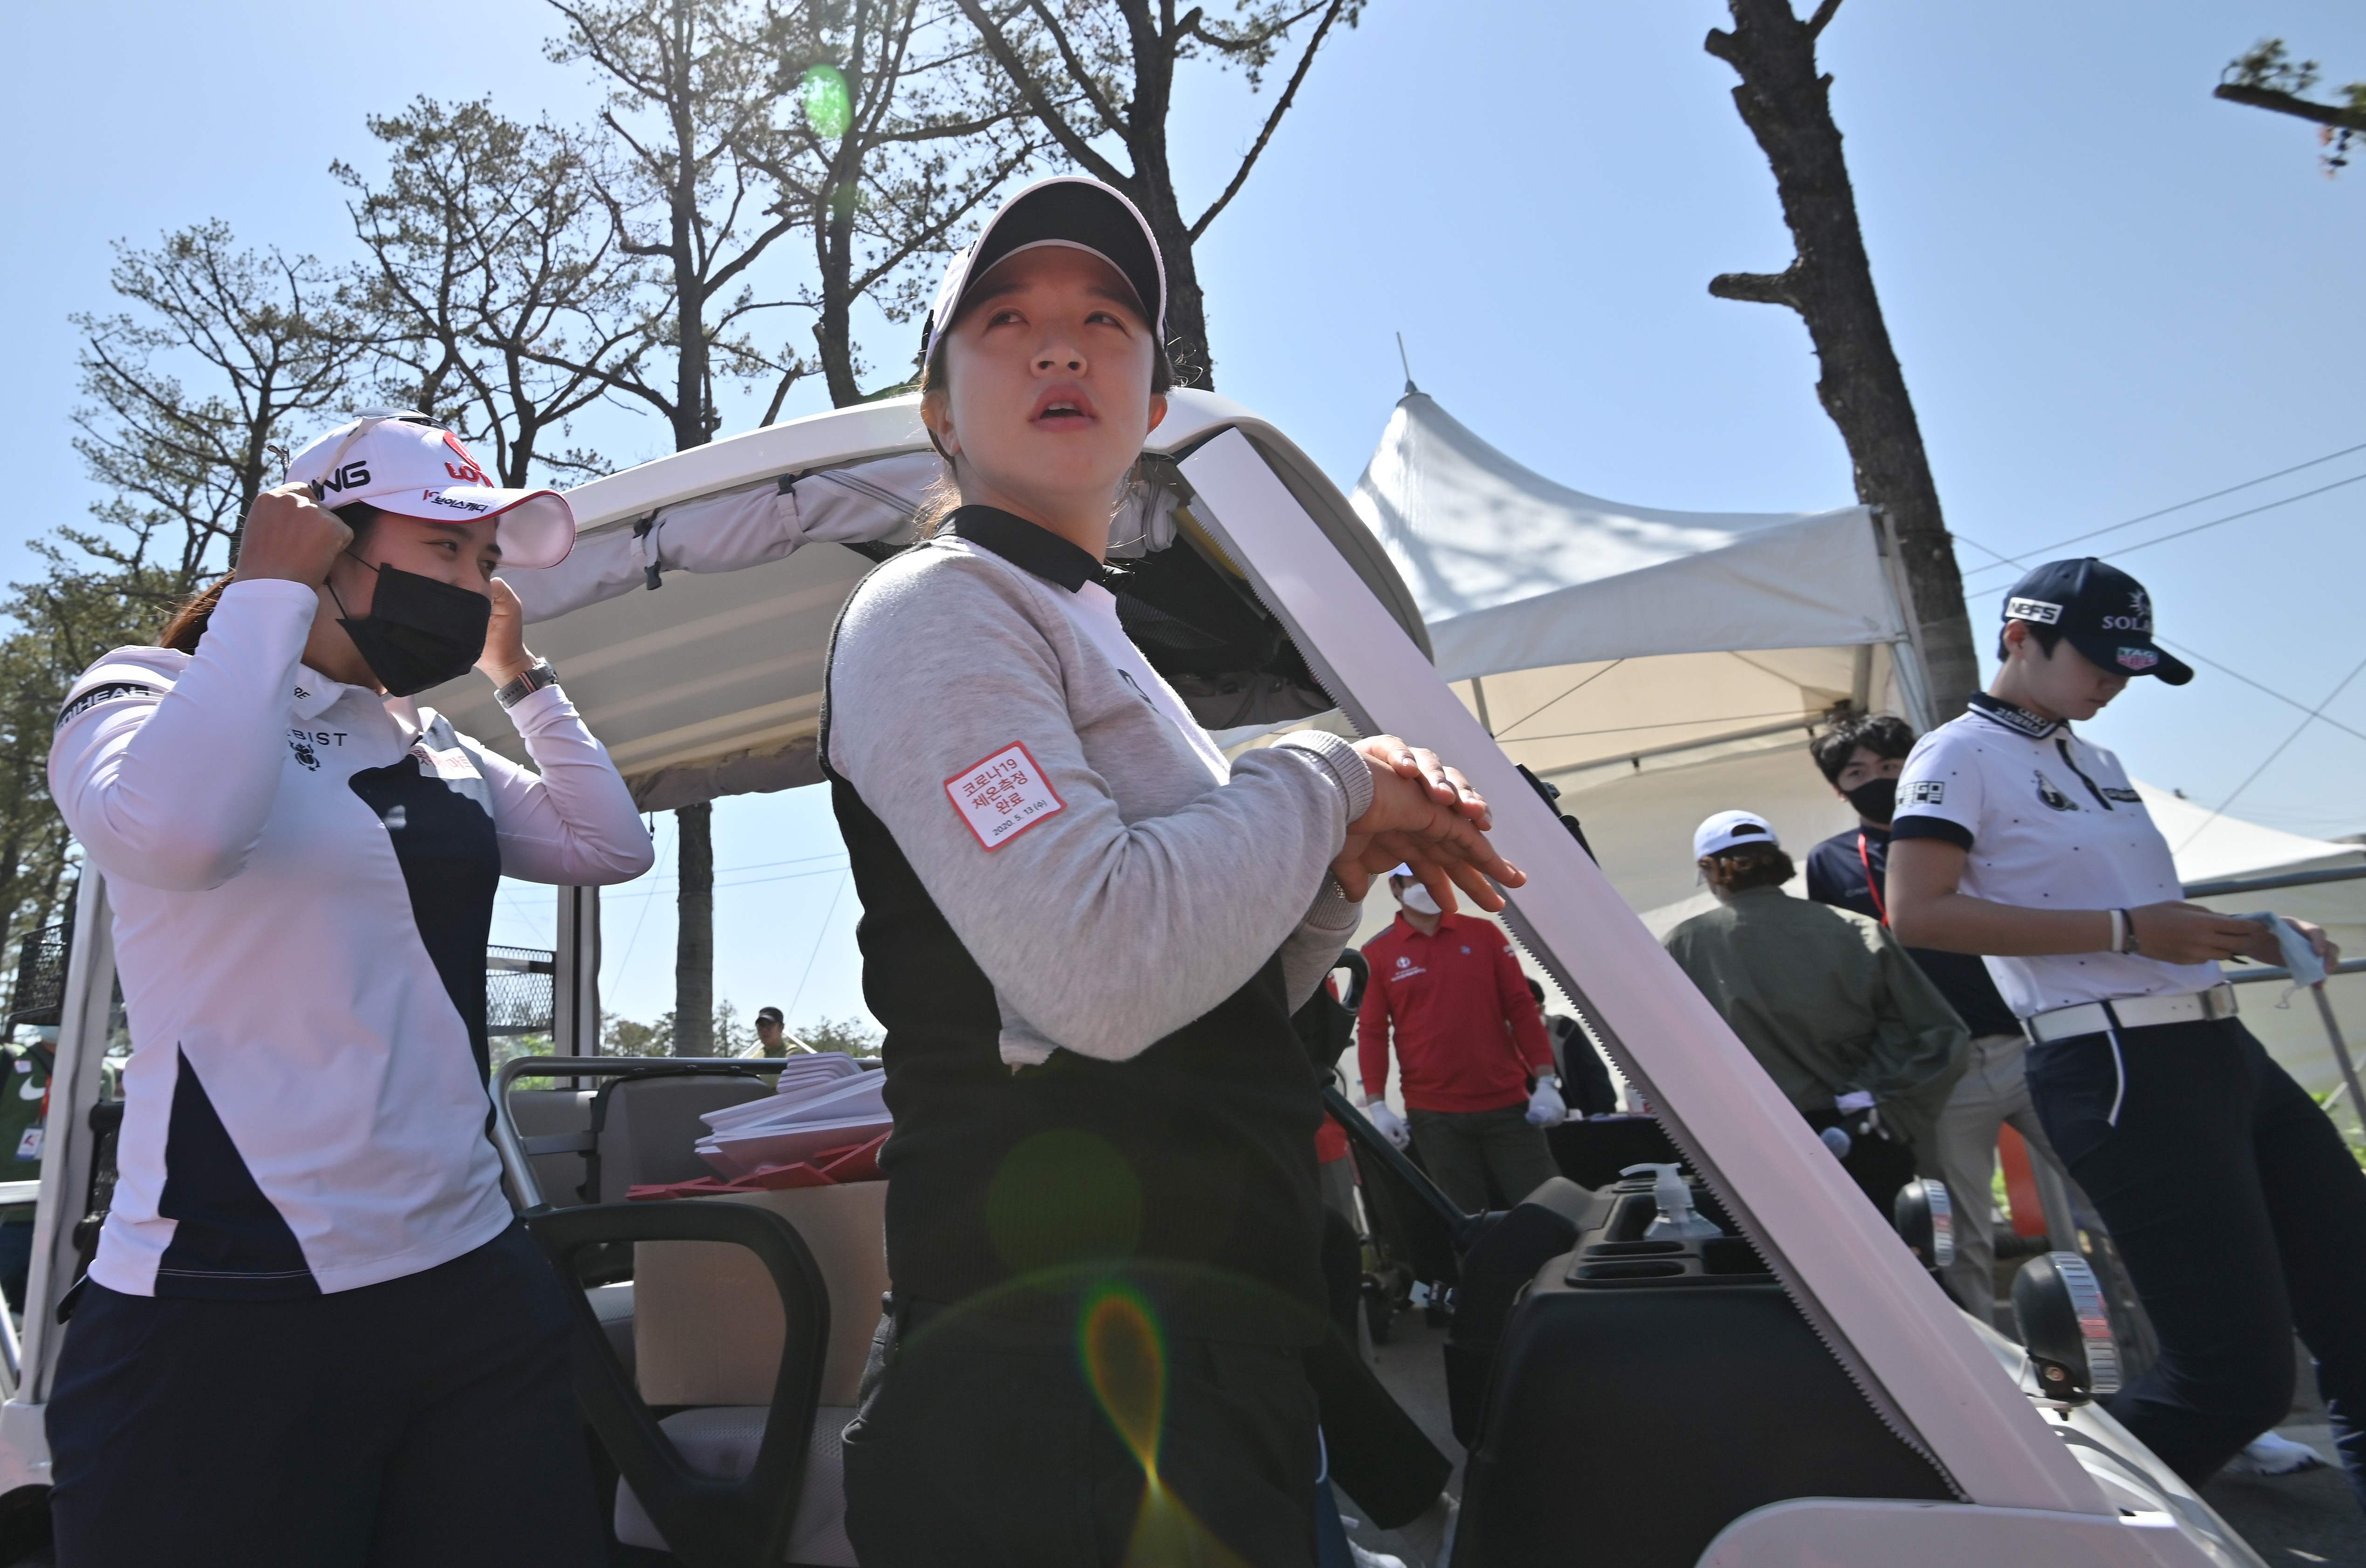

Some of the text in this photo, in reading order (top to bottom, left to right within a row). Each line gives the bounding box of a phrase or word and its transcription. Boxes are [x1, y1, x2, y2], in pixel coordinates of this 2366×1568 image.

[431, 496, 488, 513] 보이스캐디
[287, 729, 348, 746] BIST
[962, 759, 1017, 797] 코로나19
[971, 770, 1028, 809] 체온측정
[996, 792, 1025, 815] 완료
